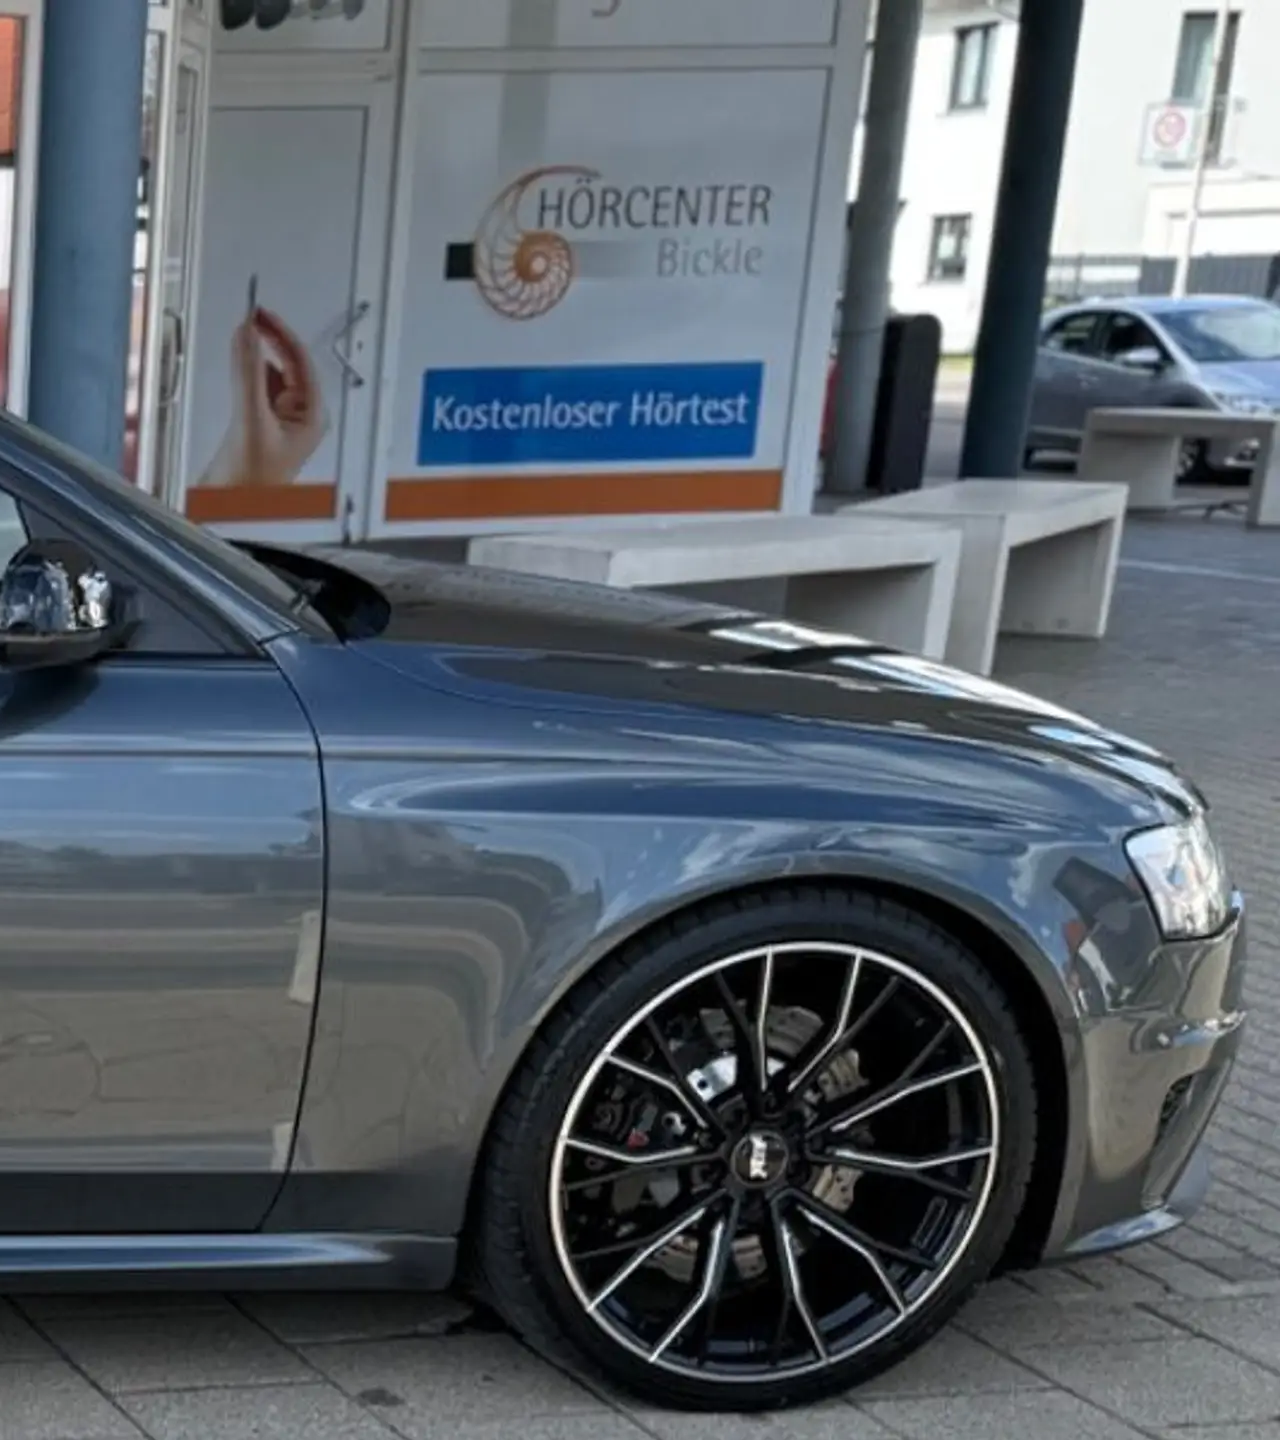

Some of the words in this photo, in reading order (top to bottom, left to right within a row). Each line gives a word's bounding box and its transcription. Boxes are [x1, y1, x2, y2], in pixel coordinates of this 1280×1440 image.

[537, 177, 773, 230] HÖRCENTER
[655, 237, 764, 277] Bickle
[432, 393, 621, 431] Kostenloser
[629, 388, 748, 427] Hörtest
